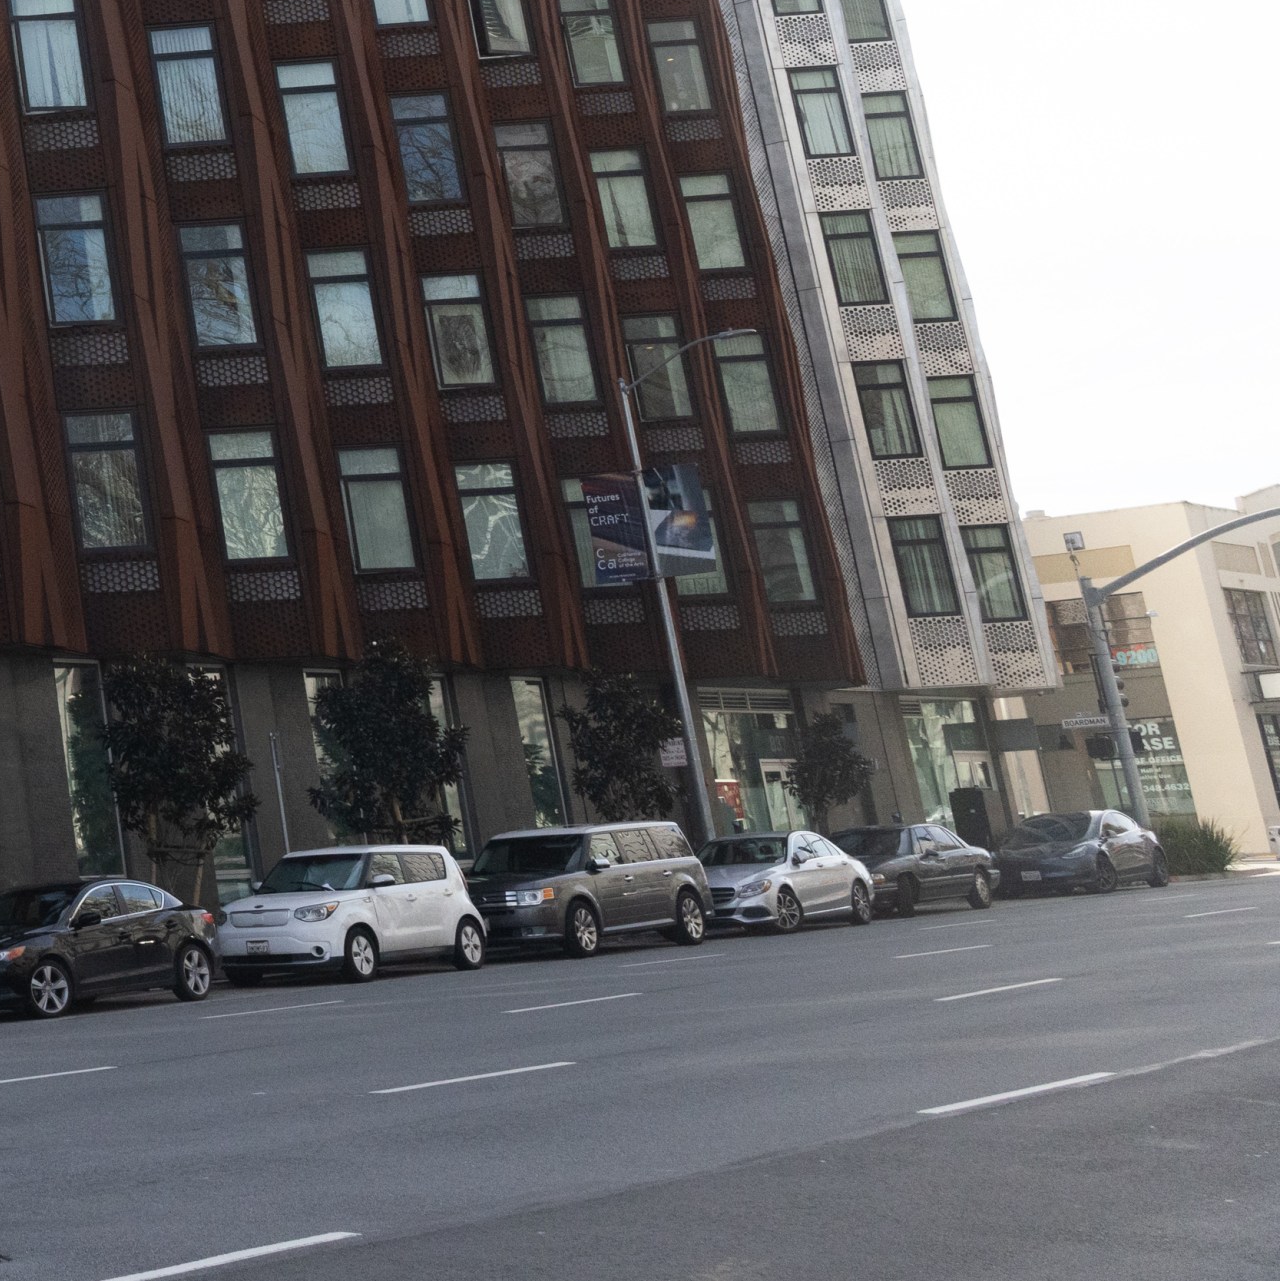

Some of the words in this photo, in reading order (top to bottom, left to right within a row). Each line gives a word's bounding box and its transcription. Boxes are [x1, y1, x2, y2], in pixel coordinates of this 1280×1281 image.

[586, 494, 620, 504] Futures
[588, 505, 598, 514] of
[590, 513, 629, 527] CRAFT
[1116, 649, 1158, 666] 9200
[1064, 718, 1107, 727] BOARDMAN
